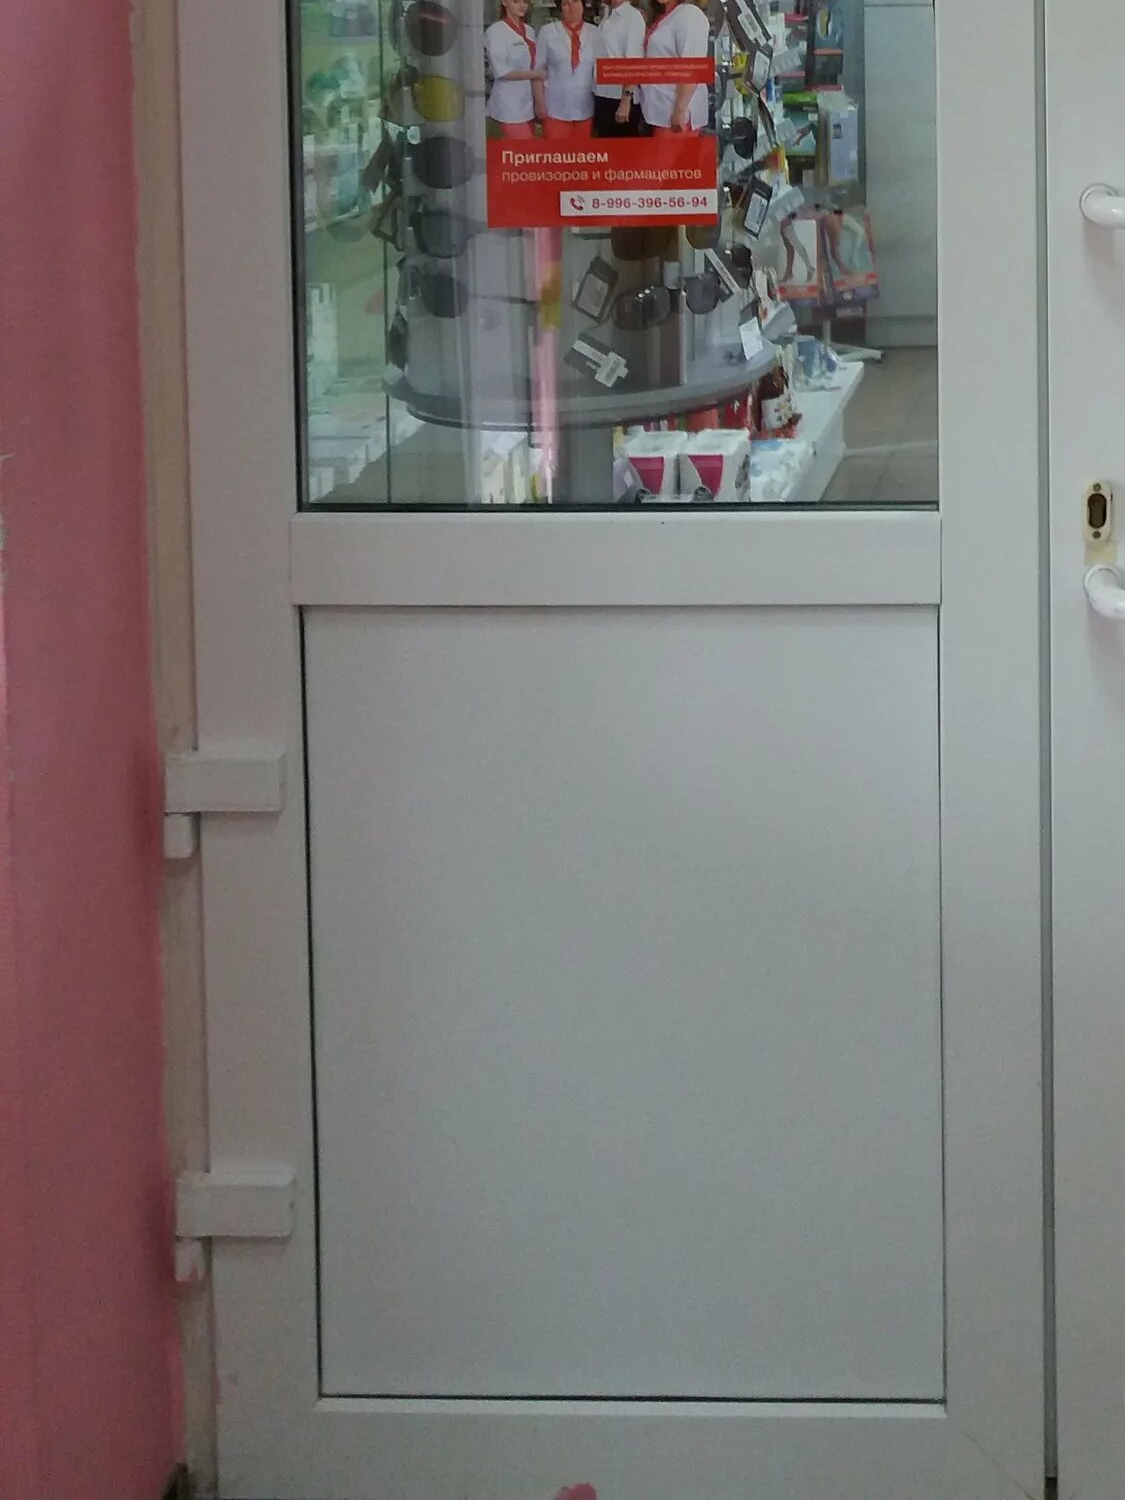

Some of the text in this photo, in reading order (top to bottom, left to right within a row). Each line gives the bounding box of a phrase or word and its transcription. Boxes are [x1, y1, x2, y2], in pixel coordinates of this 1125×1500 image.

[501, 150, 609, 167] Приглашаем
[502, 167, 702, 183] провизоров и фармацевтов
[591, 196, 708, 209] 8-996-396-56-94
